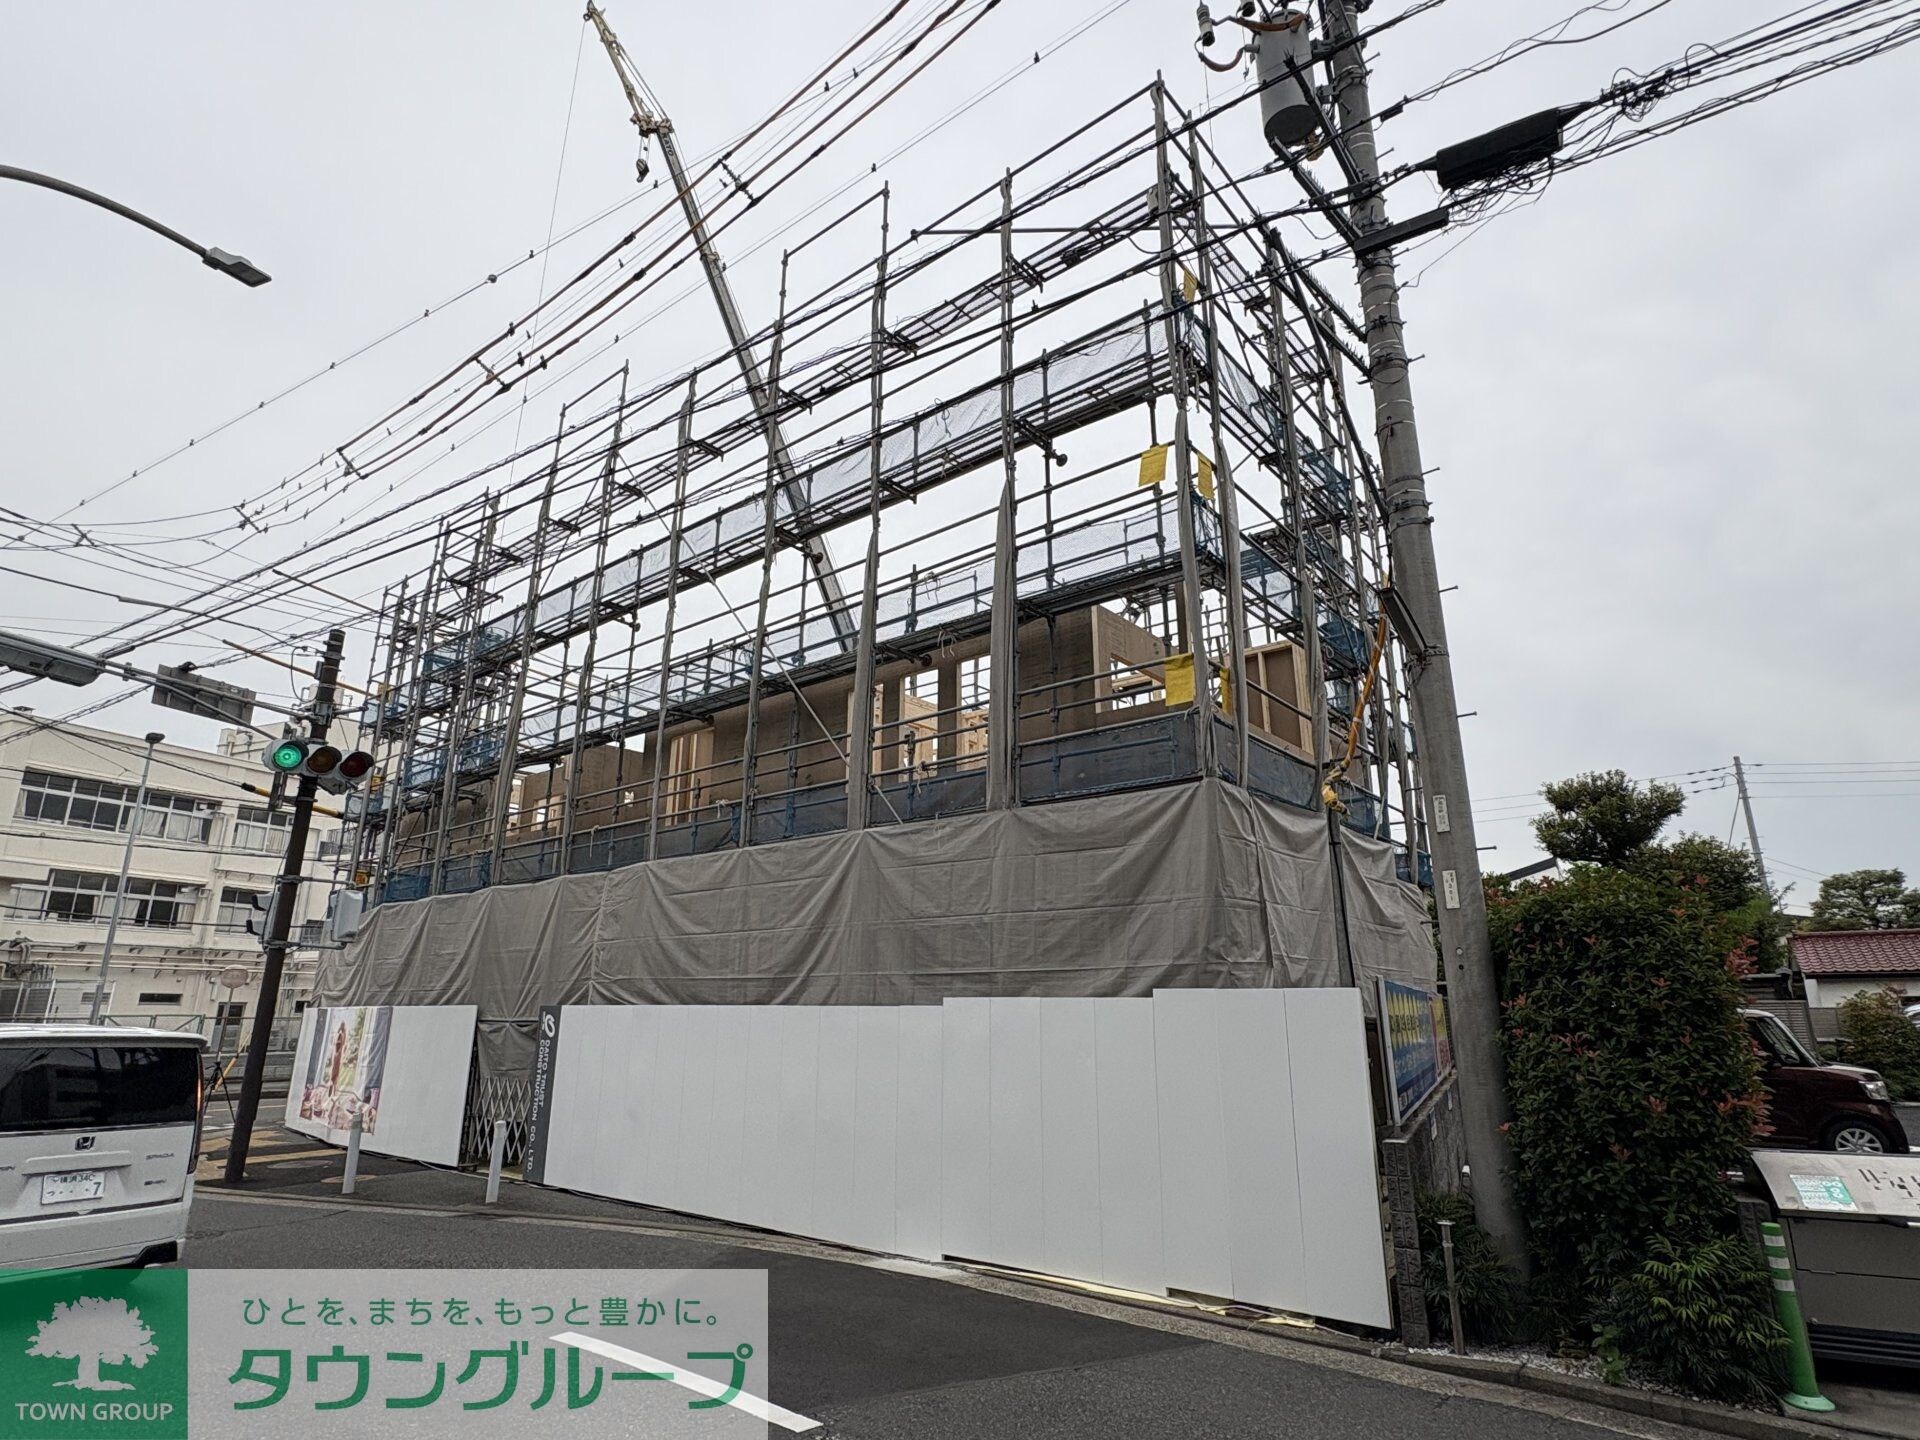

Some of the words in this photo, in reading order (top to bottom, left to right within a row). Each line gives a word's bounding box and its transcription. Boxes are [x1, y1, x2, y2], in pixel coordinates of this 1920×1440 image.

[661, 133, 674, 156] KATO
[542, 1039, 551, 1071] DAITO
[531, 1039, 545, 1121] CONSTRUCTION
[538, 1074, 547, 1107] TRUST
[526, 1149, 534, 1173] LTD.
